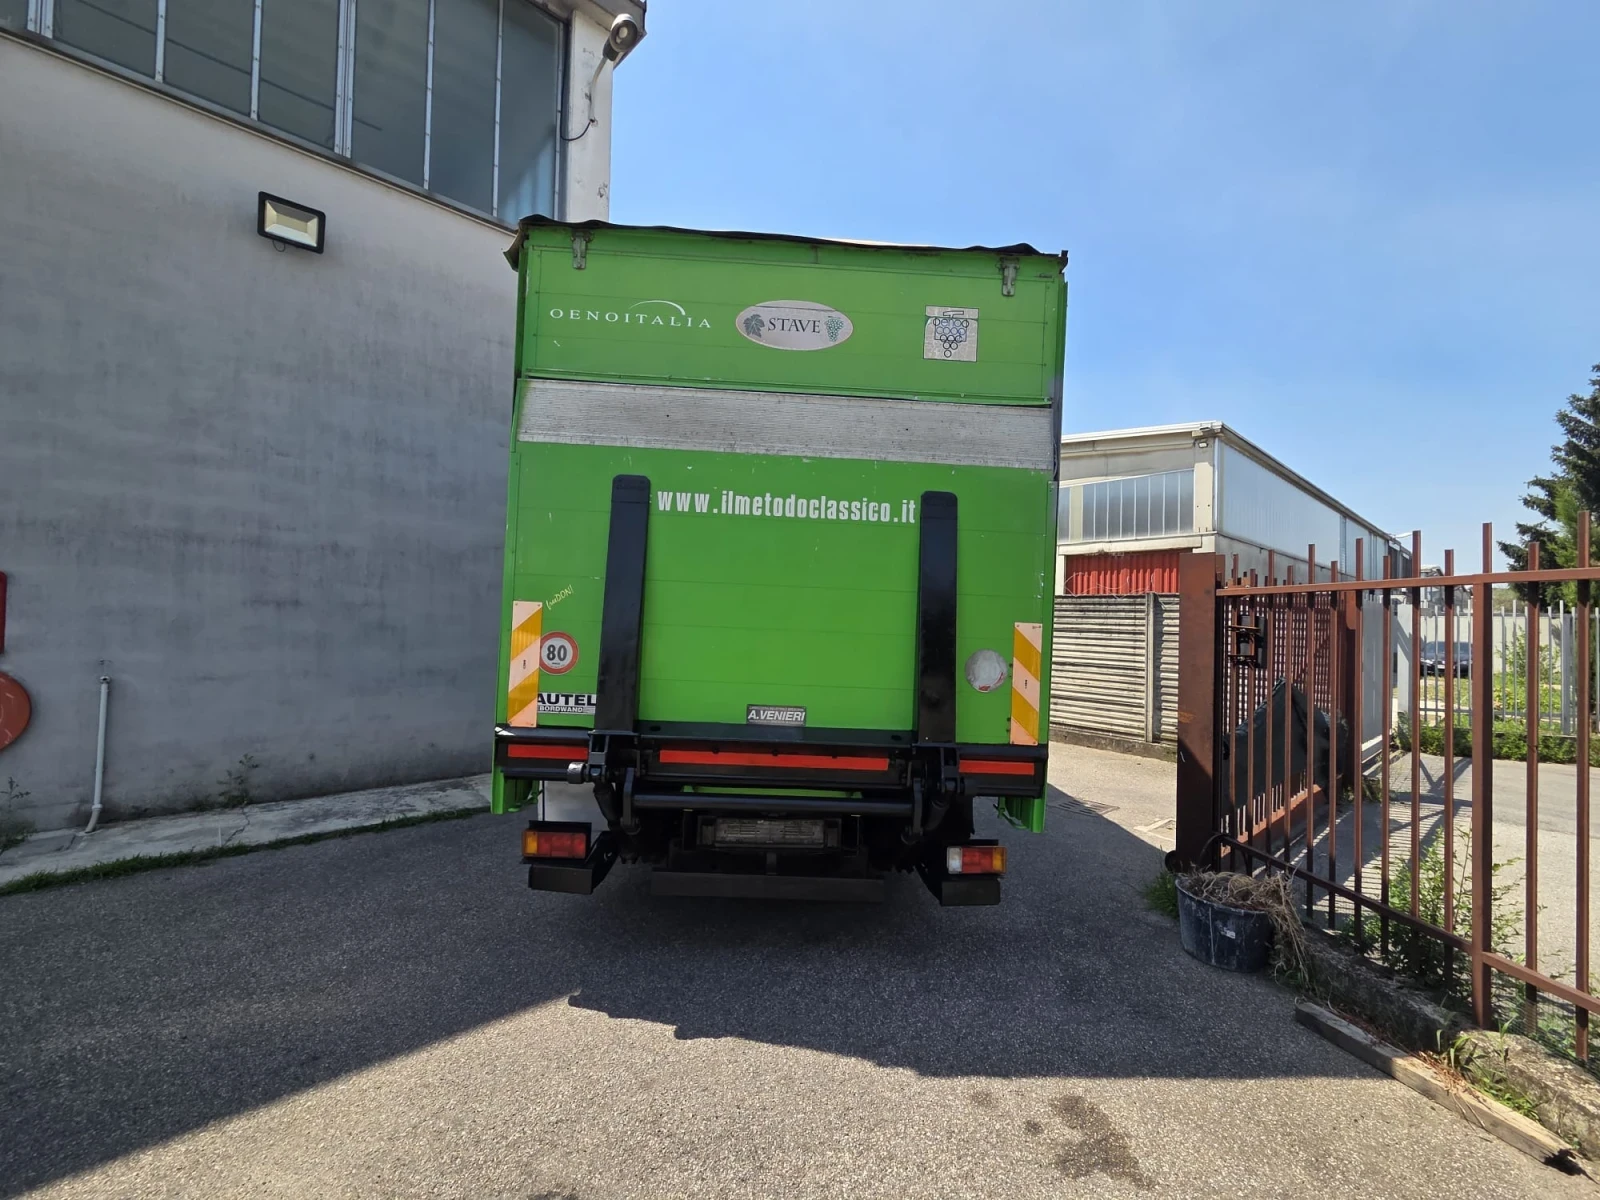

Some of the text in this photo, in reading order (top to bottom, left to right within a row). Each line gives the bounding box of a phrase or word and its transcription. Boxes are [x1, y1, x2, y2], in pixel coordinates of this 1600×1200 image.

[550, 308, 711, 328] OENOITALIA
[767, 318, 820, 333] STAVE
[657, 491, 915, 523] www.ilmetodoclassico.it
[546, 644, 567, 661] 80
[748, 709, 806, 721] A.VENIERI
